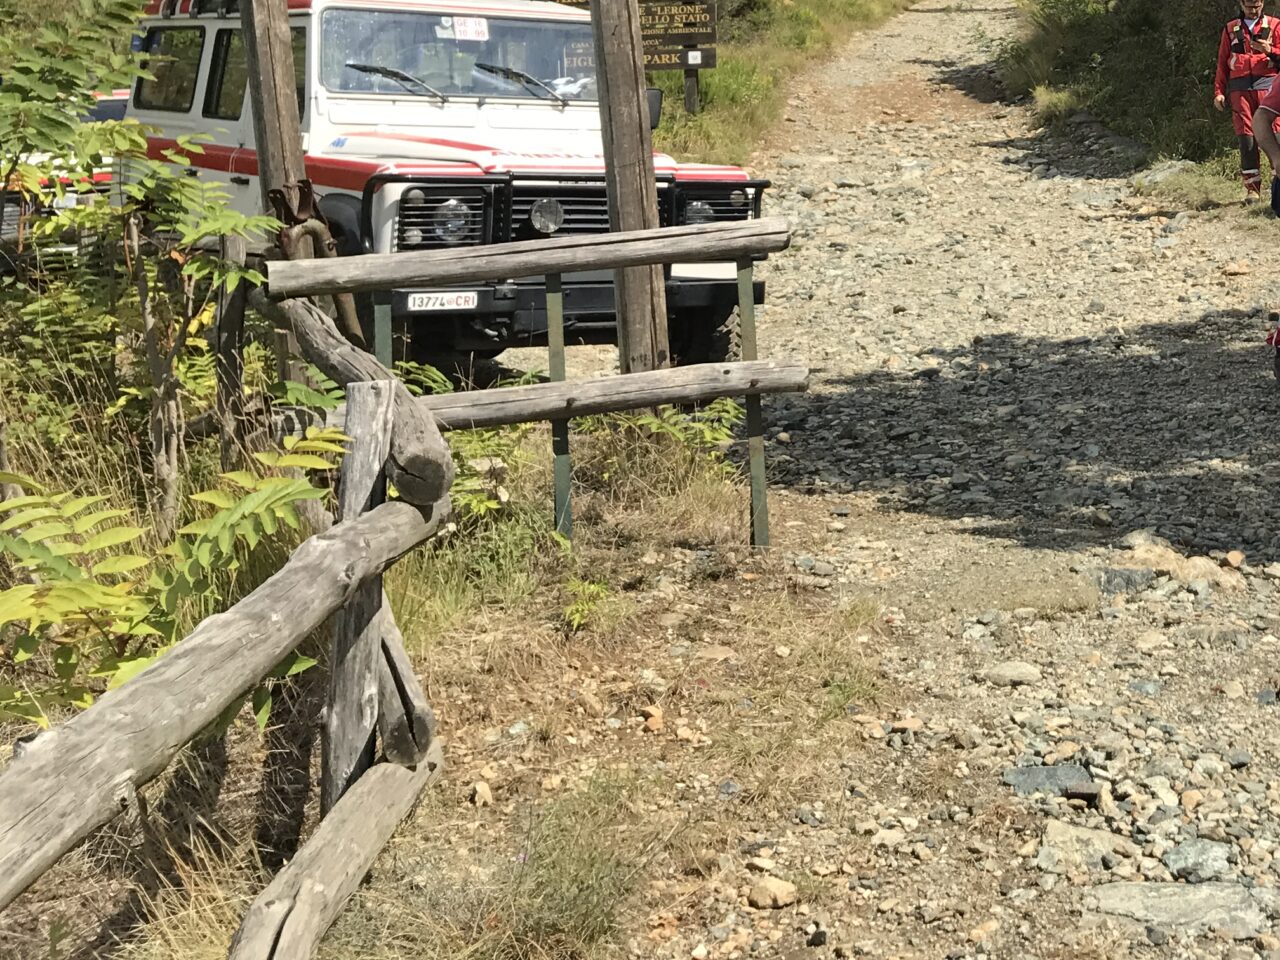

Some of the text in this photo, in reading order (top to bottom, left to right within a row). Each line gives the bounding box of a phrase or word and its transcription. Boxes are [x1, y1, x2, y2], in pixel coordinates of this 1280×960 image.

[640, 13, 710, 24] ELLO STATO
[643, 53, 681, 65] PARK
[455, 295, 475, 307] CRI
